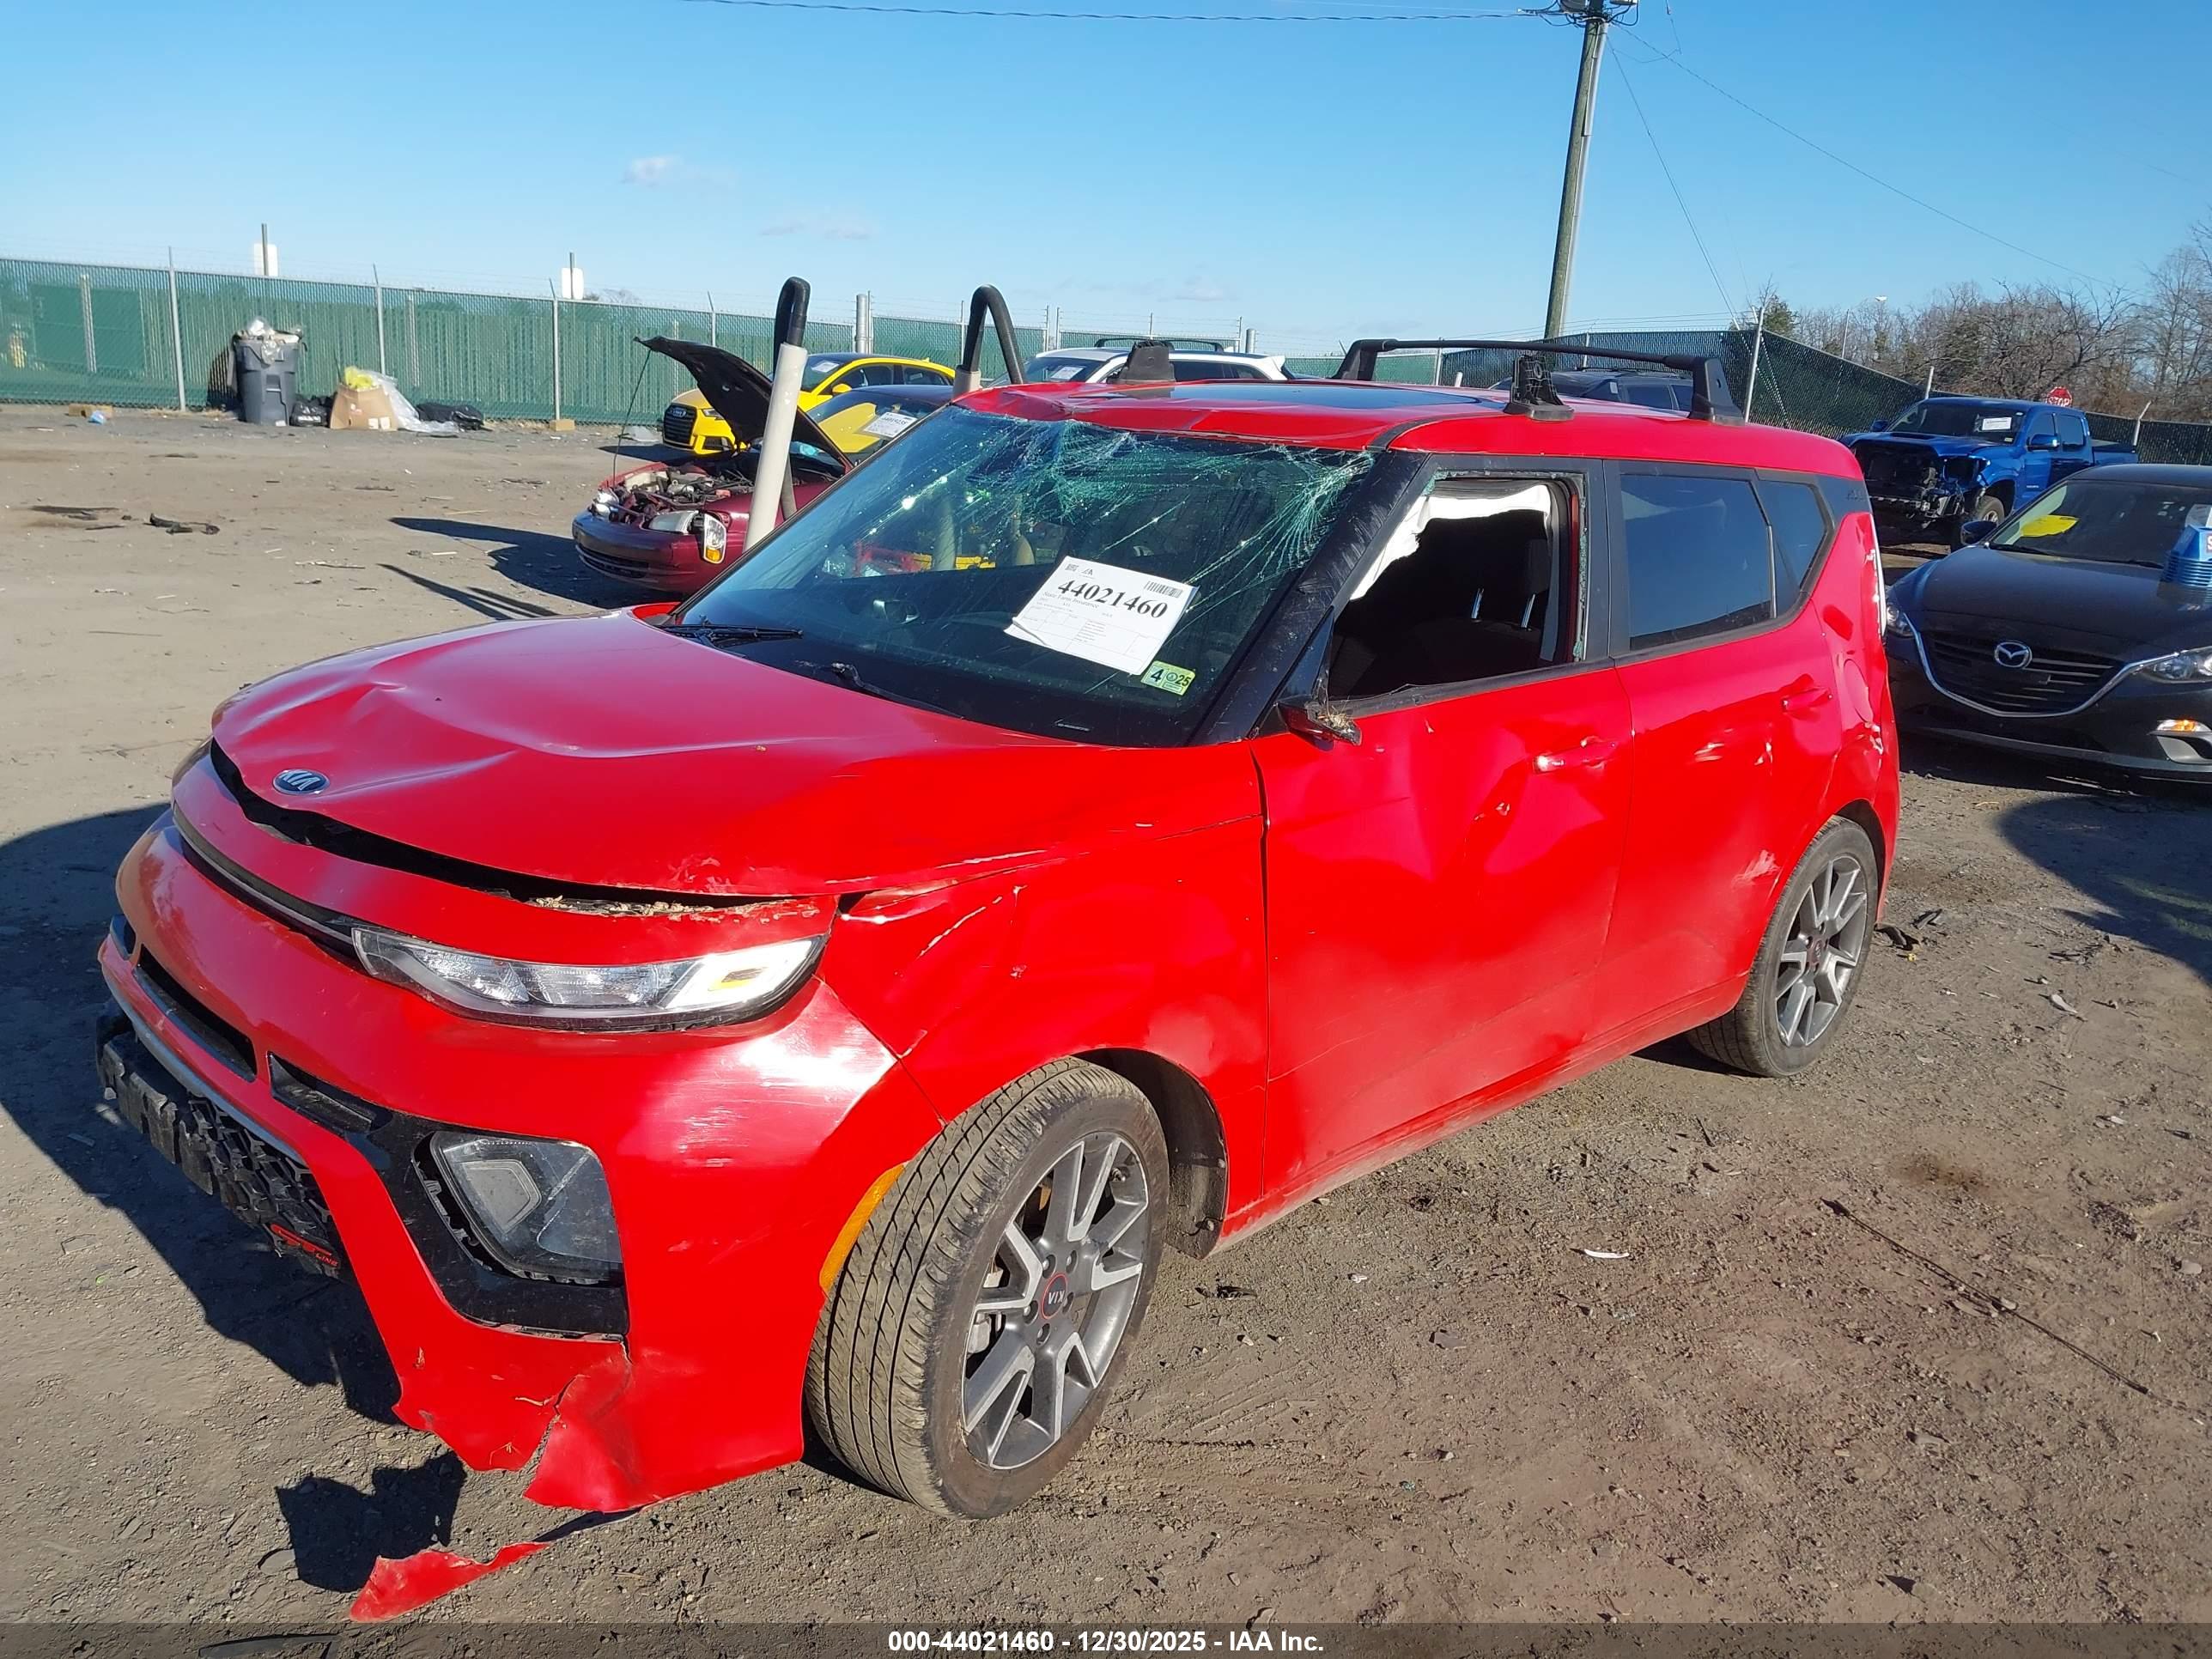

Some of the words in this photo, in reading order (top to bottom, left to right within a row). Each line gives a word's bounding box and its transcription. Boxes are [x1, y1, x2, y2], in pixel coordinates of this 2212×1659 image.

[2049, 397, 2070, 406] STOP
[1058, 580, 1168, 618] 44021460
[1151, 669, 1164, 683] 4
[1175, 674, 1192, 687] 25
[316, 1253, 338, 1267] LINE
